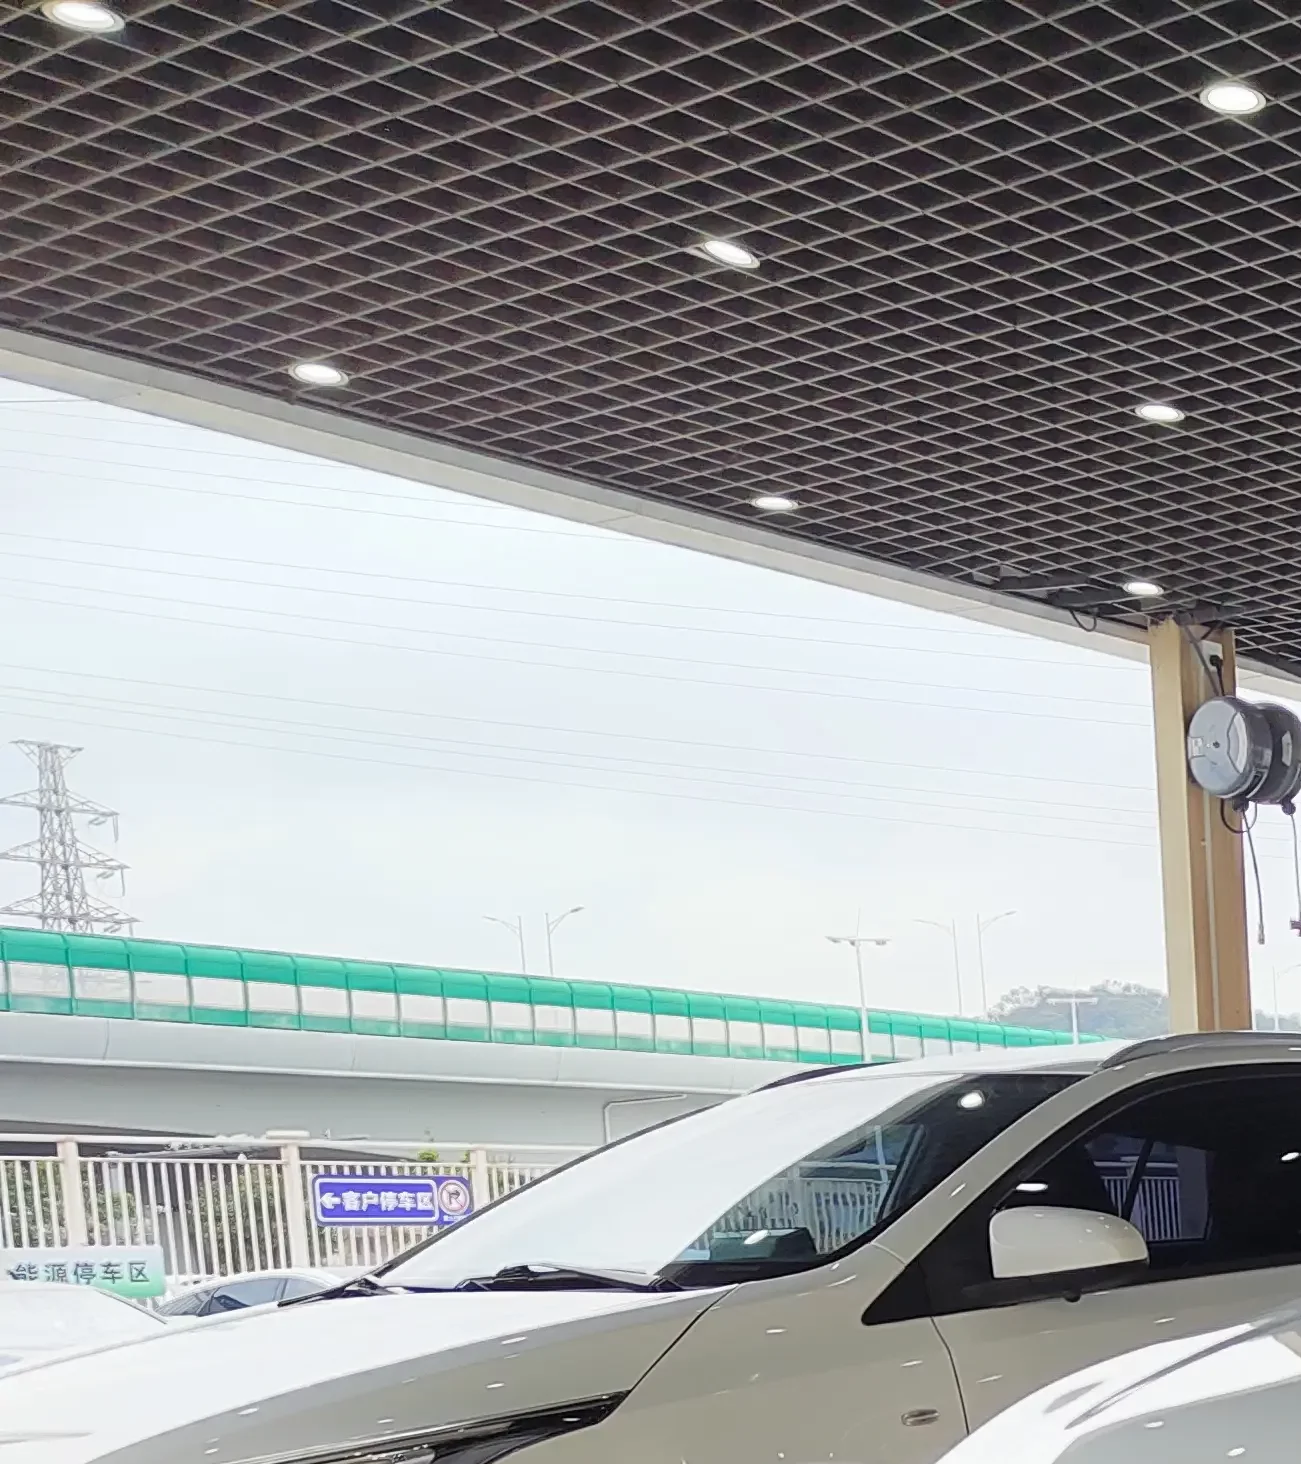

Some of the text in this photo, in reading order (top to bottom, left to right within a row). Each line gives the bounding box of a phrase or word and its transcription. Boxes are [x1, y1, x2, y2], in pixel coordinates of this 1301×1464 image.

[341, 1190, 435, 1212] 客户停车区
